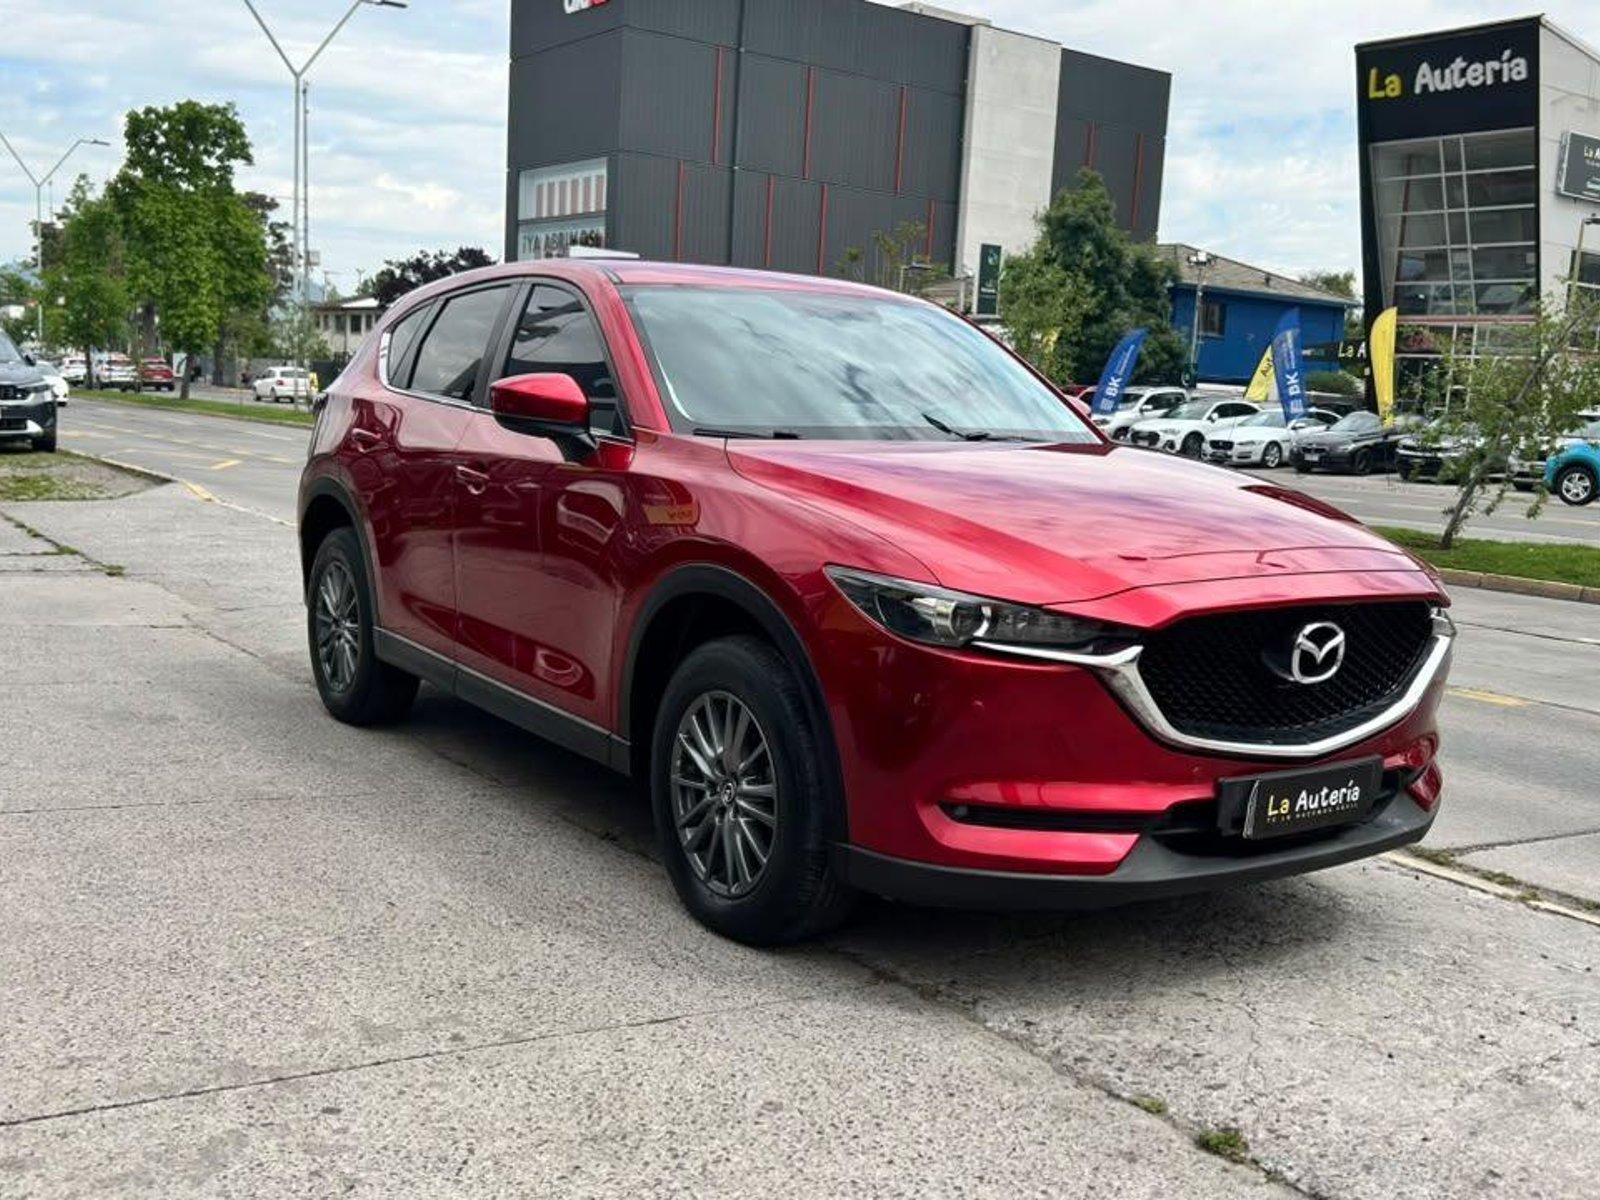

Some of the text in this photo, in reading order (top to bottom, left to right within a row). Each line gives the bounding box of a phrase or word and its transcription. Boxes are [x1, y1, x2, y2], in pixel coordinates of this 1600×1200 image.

[1368, 48, 1528, 99] La Autería
[1338, 341, 1353, 358] La
[1105, 376, 1123, 397] BK
[1285, 371, 1301, 396] BK
[1267, 779, 1361, 816] La Autería
